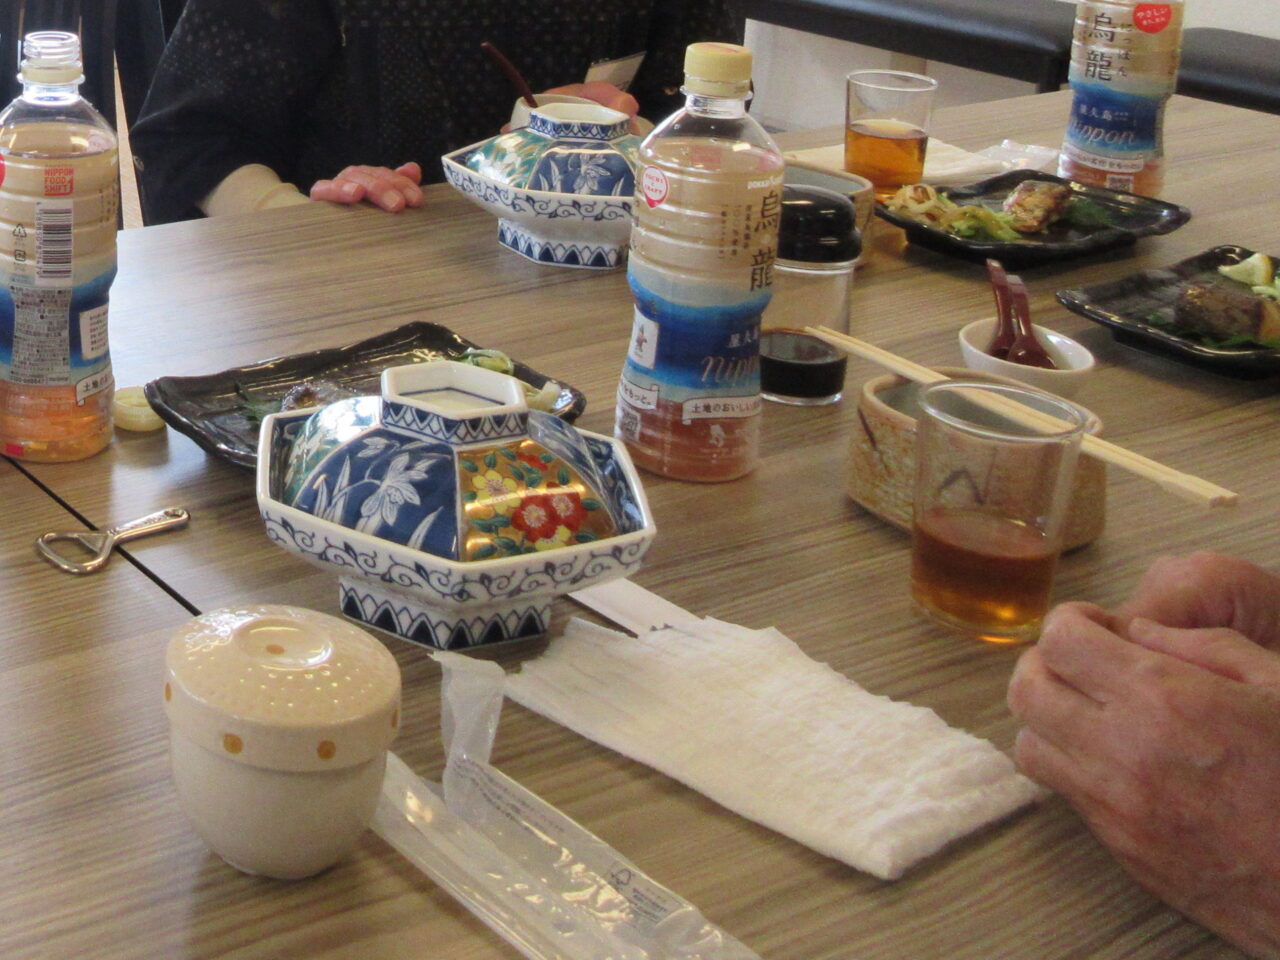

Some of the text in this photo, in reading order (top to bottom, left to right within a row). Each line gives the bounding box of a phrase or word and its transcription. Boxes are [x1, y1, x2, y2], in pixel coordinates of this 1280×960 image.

[43, 167, 74, 177] NIPPON
[43, 176, 67, 185] FOOD
[43, 184, 68, 194] SHIFT
